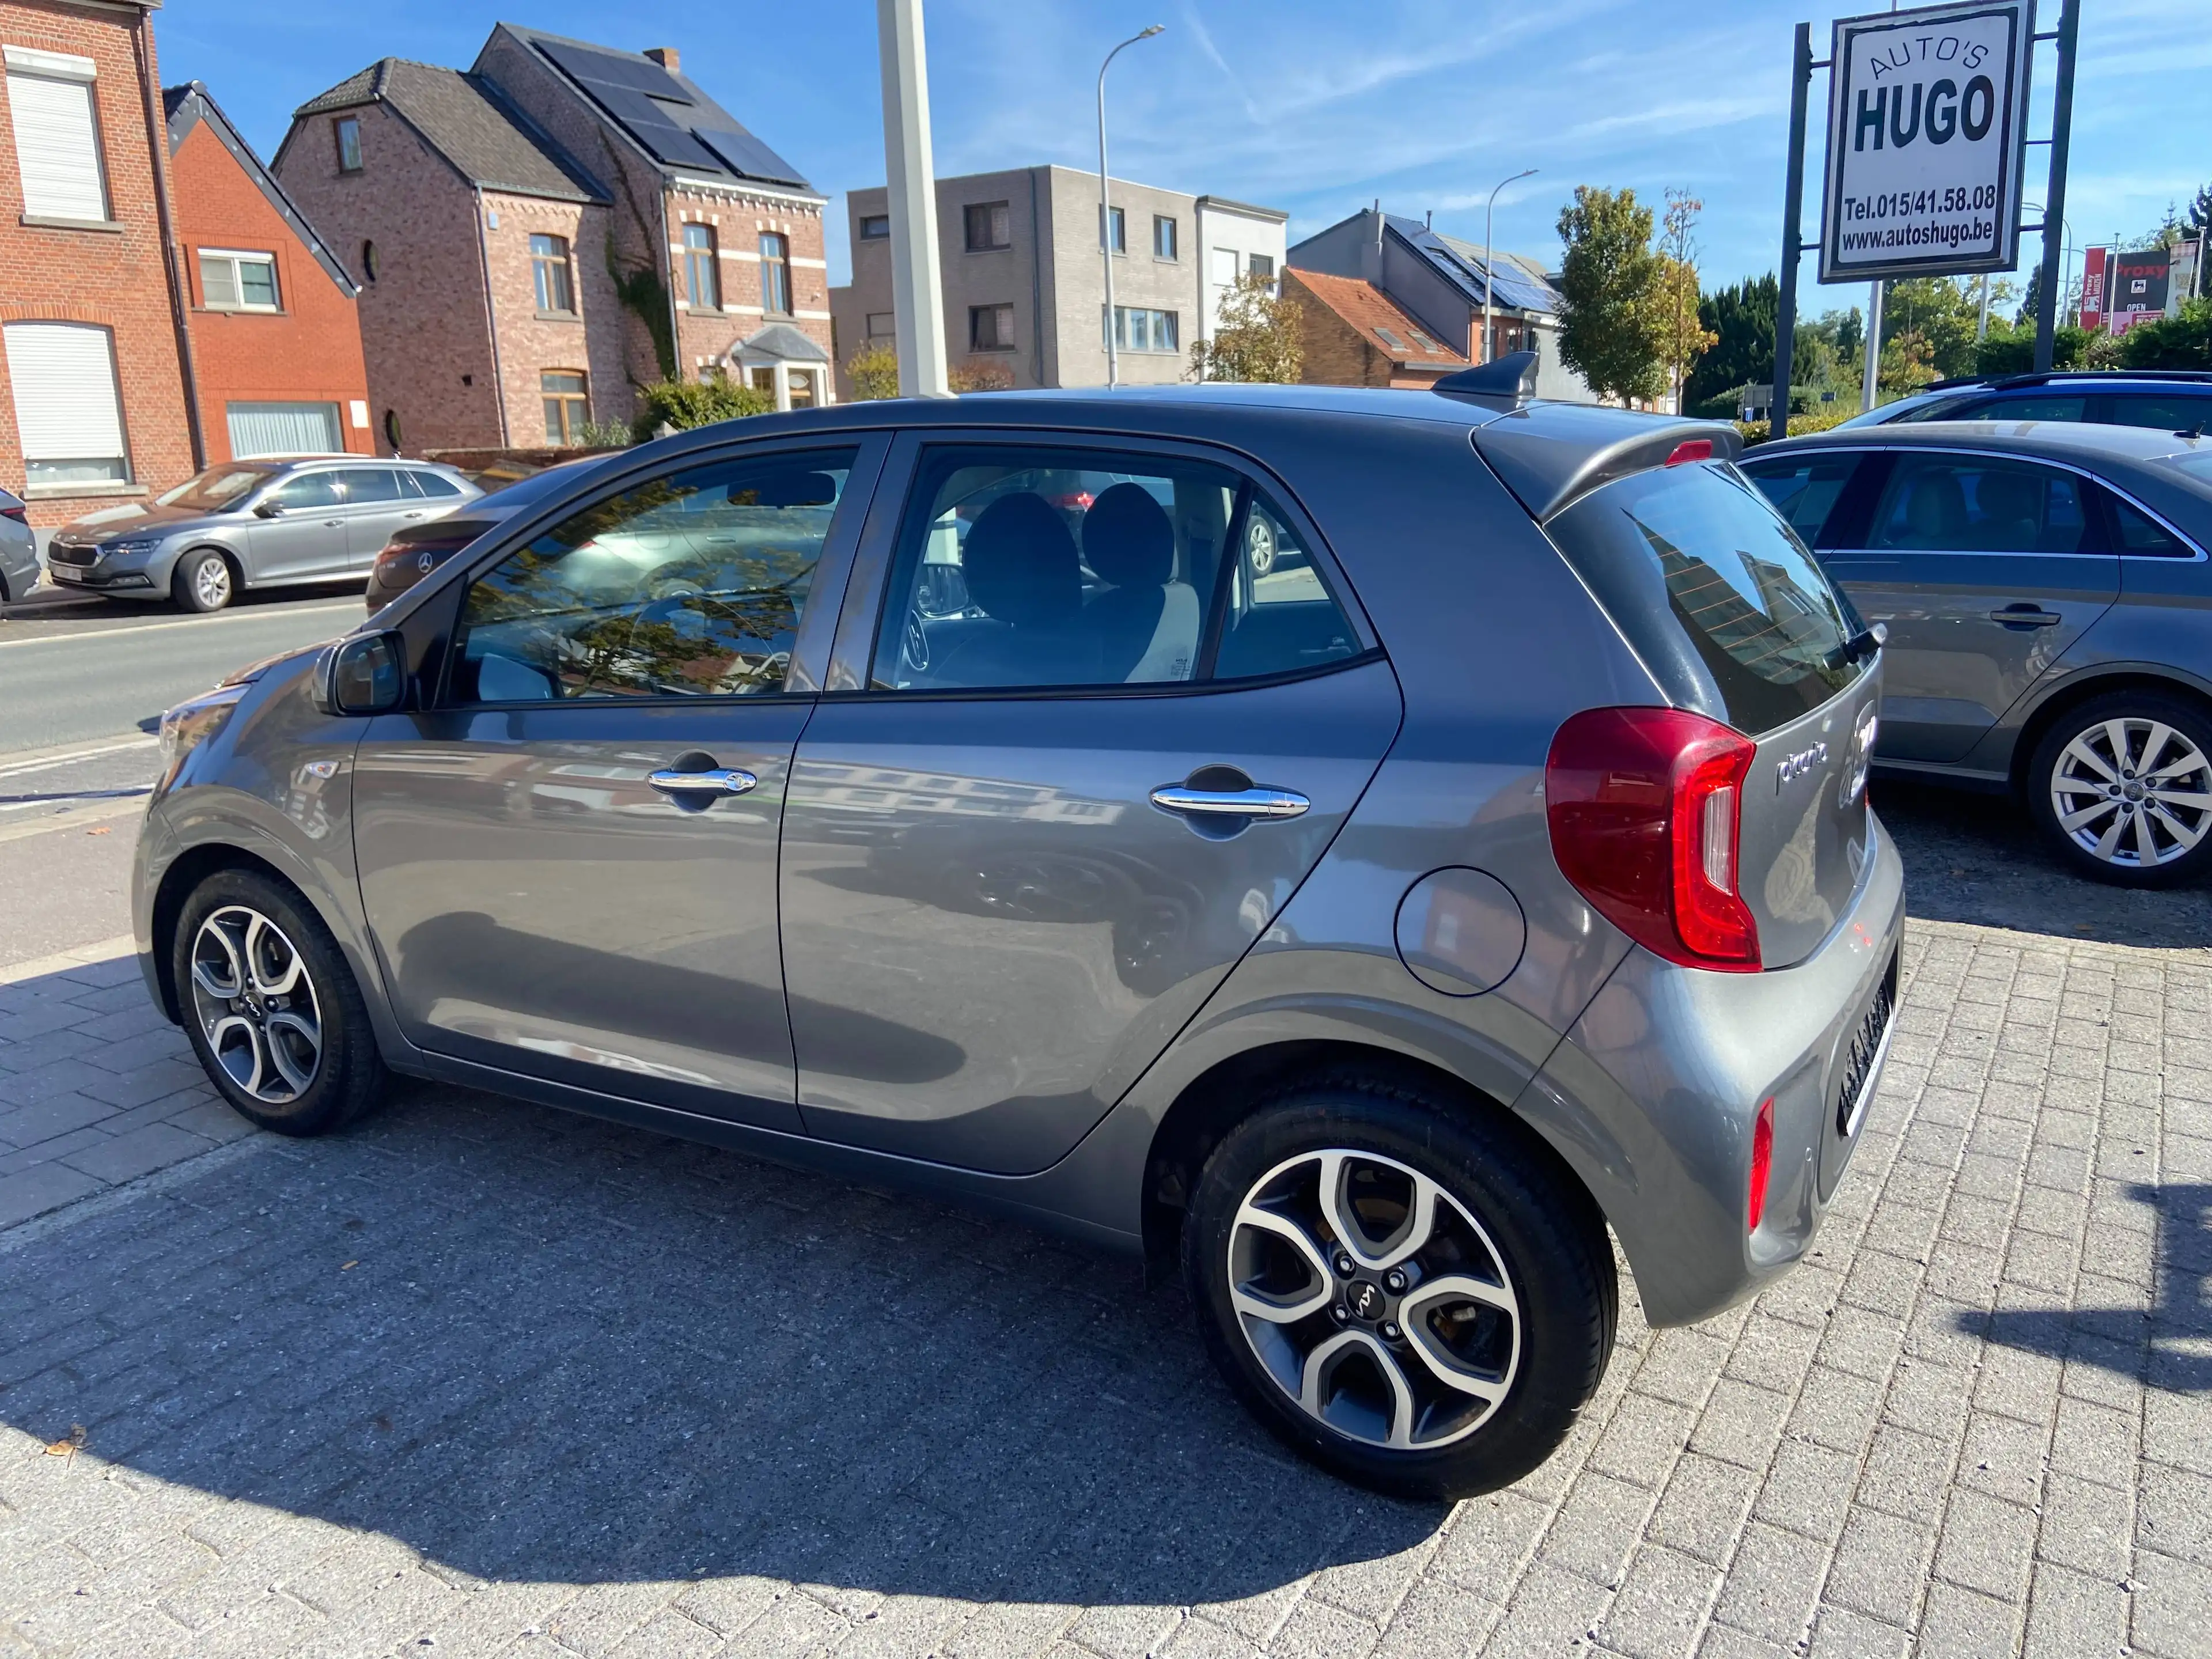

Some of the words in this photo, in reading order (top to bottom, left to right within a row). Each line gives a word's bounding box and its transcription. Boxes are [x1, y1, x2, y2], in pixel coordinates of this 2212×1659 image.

[1870, 37, 1988, 79] AUTO'S
[1854, 75, 1994, 151] HUGO
[1844, 185, 1995, 221] Tel.015/41.58.08
[1843, 217, 1993, 251] www.autoshugo.be
[2126, 303, 2146, 312] OPEN
